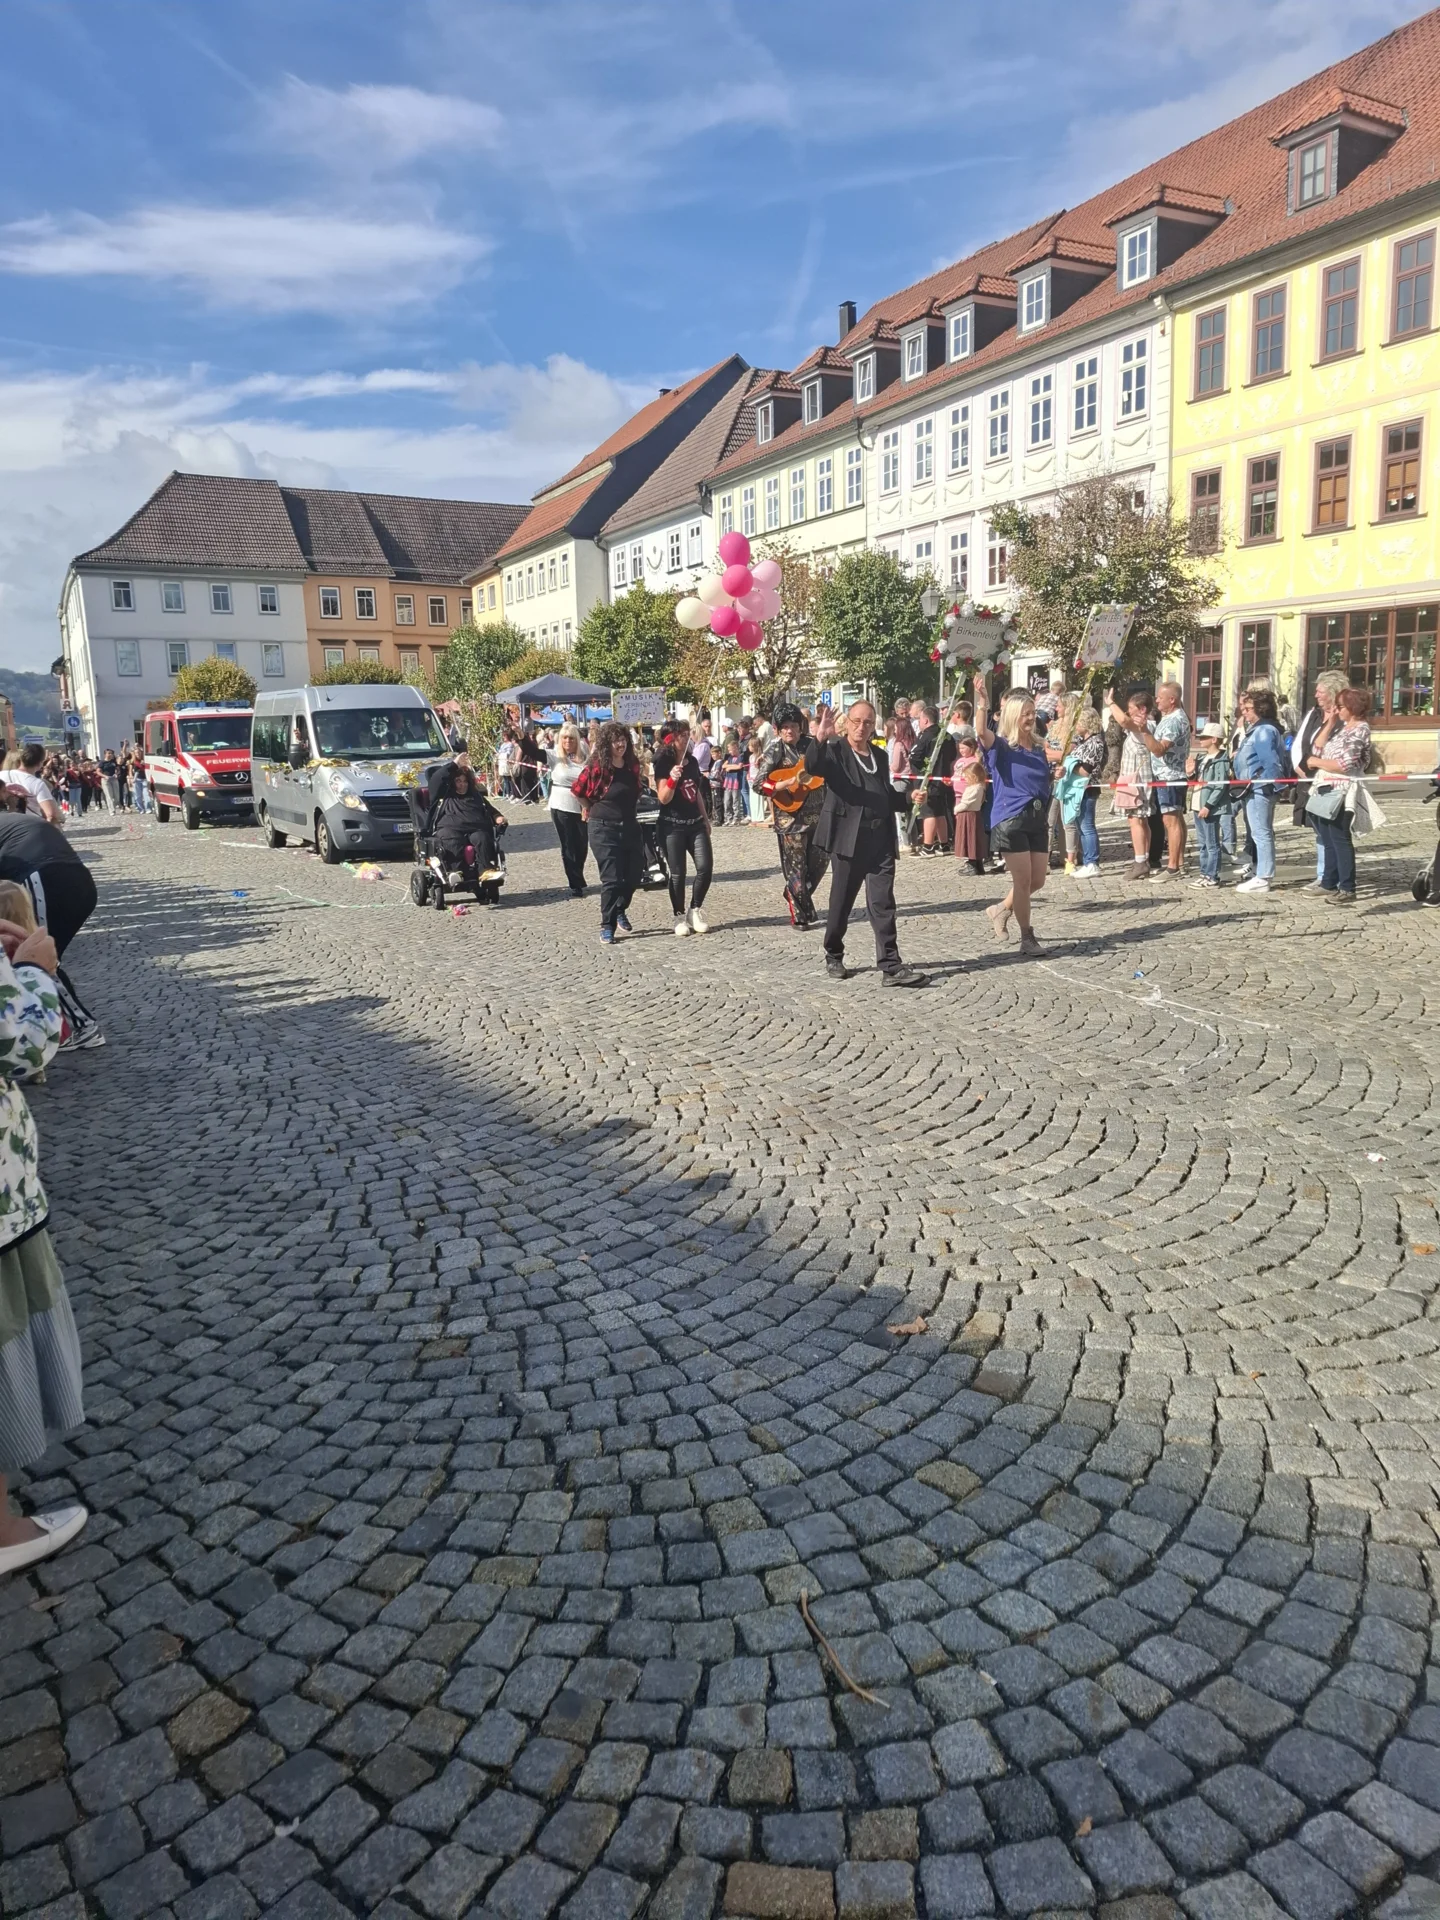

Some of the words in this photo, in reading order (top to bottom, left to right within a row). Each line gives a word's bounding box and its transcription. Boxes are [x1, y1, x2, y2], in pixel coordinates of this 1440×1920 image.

[956, 626, 998, 641] Birkenfeld
[1095, 626, 1119, 636] MUSIK
[624, 693, 654, 701] MUSIK
[623, 701, 656, 709] VERBINDET
